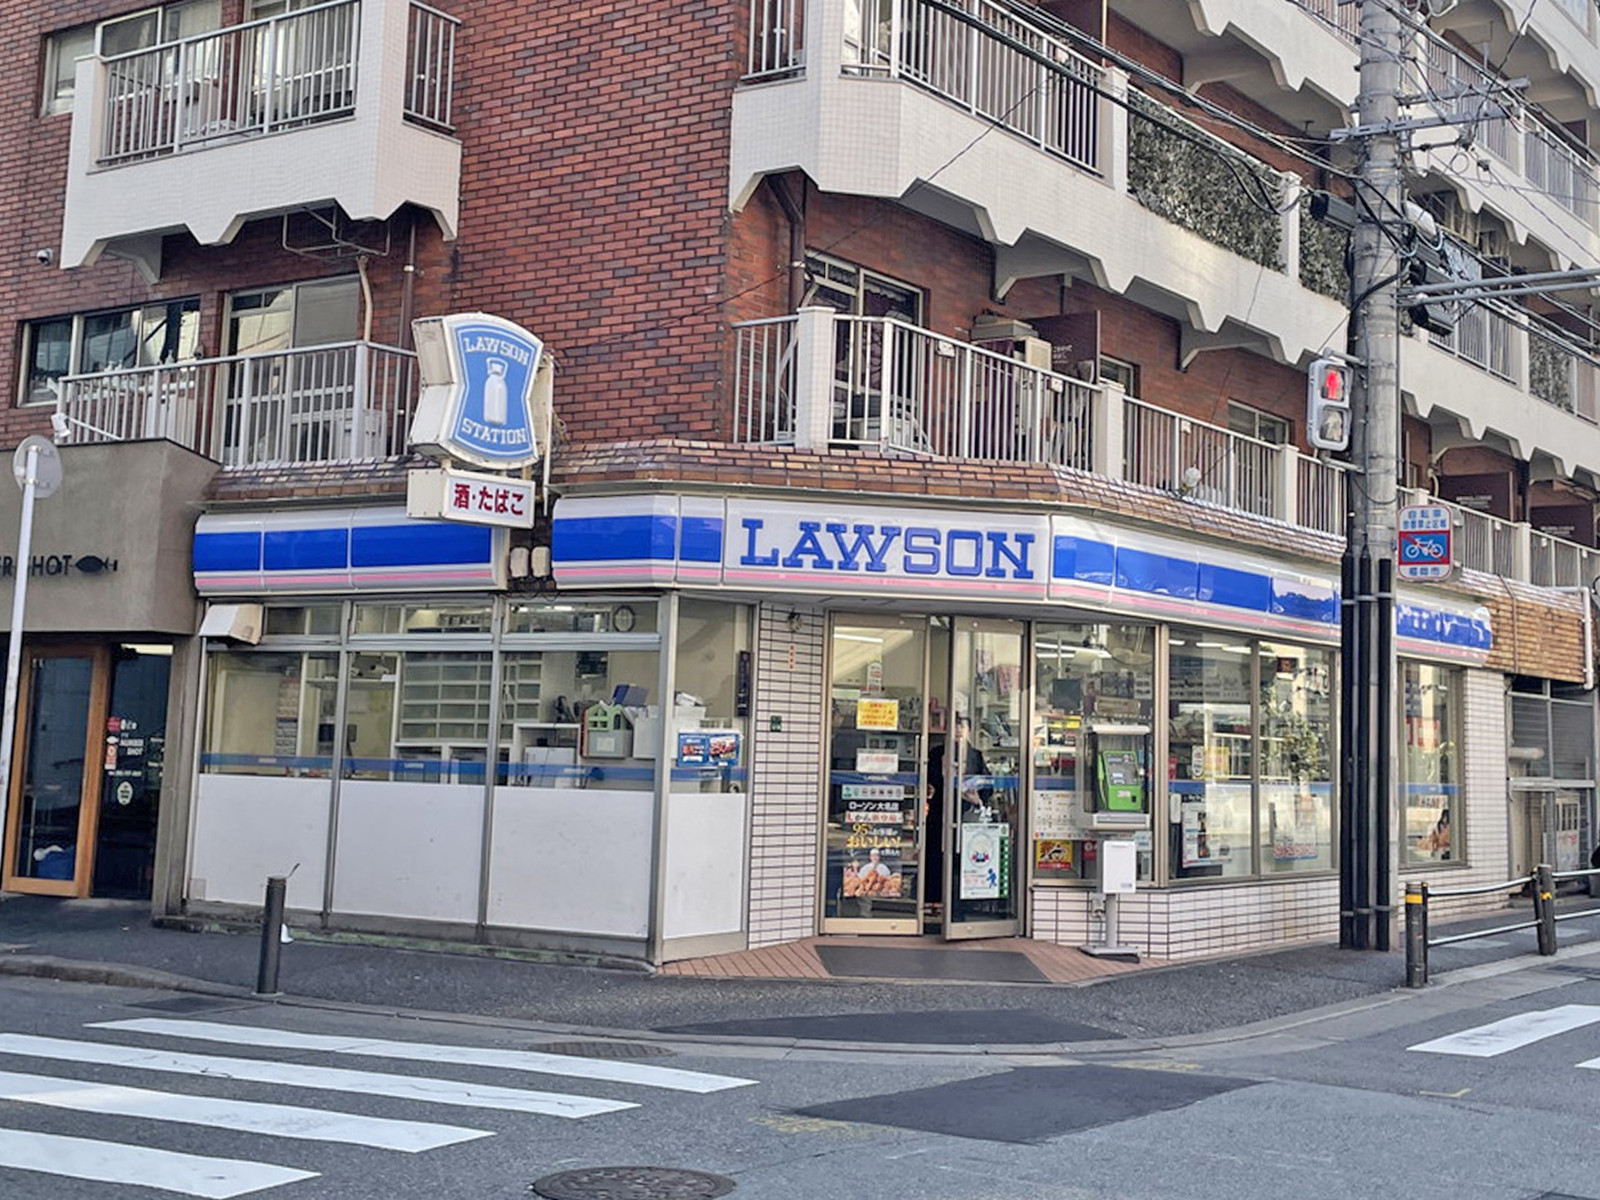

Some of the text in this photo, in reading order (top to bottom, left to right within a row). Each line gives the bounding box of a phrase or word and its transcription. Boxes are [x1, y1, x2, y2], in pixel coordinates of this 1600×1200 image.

[463, 337, 530, 366] LAWSON
[461, 418, 528, 445] STATION
[453, 483, 525, 516] 酒・たばこ
[740, 517, 1036, 580] LAWSON
[27, 555, 73, 576] HOT
